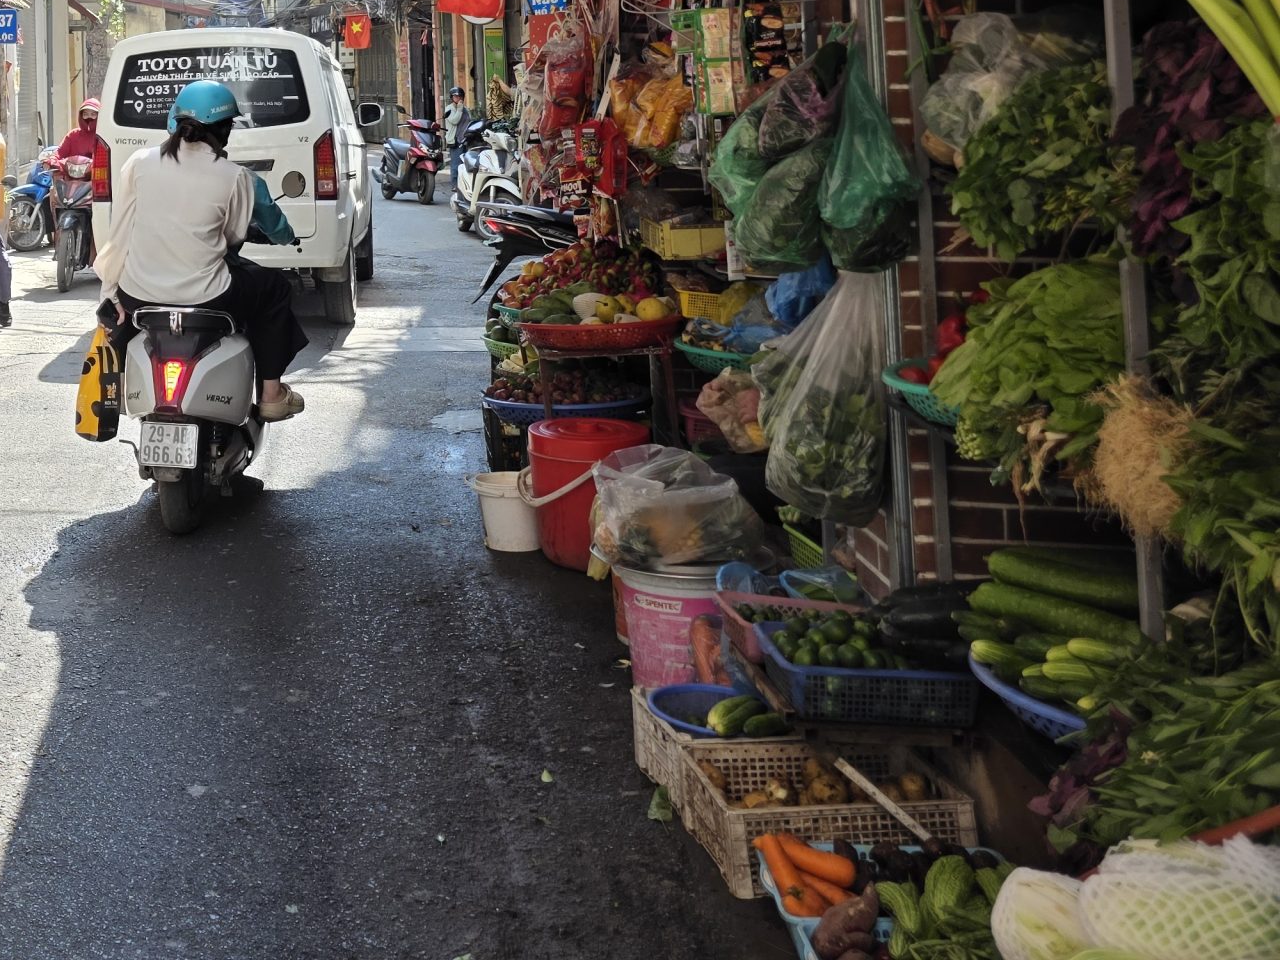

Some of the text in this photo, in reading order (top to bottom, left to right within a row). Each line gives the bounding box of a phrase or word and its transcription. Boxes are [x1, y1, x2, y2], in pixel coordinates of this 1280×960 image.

[137, 51, 278, 72] TOTO TUẤN TÚ
[170, 70, 193, 80] THIẾT
[146, 84, 170, 95] 093
